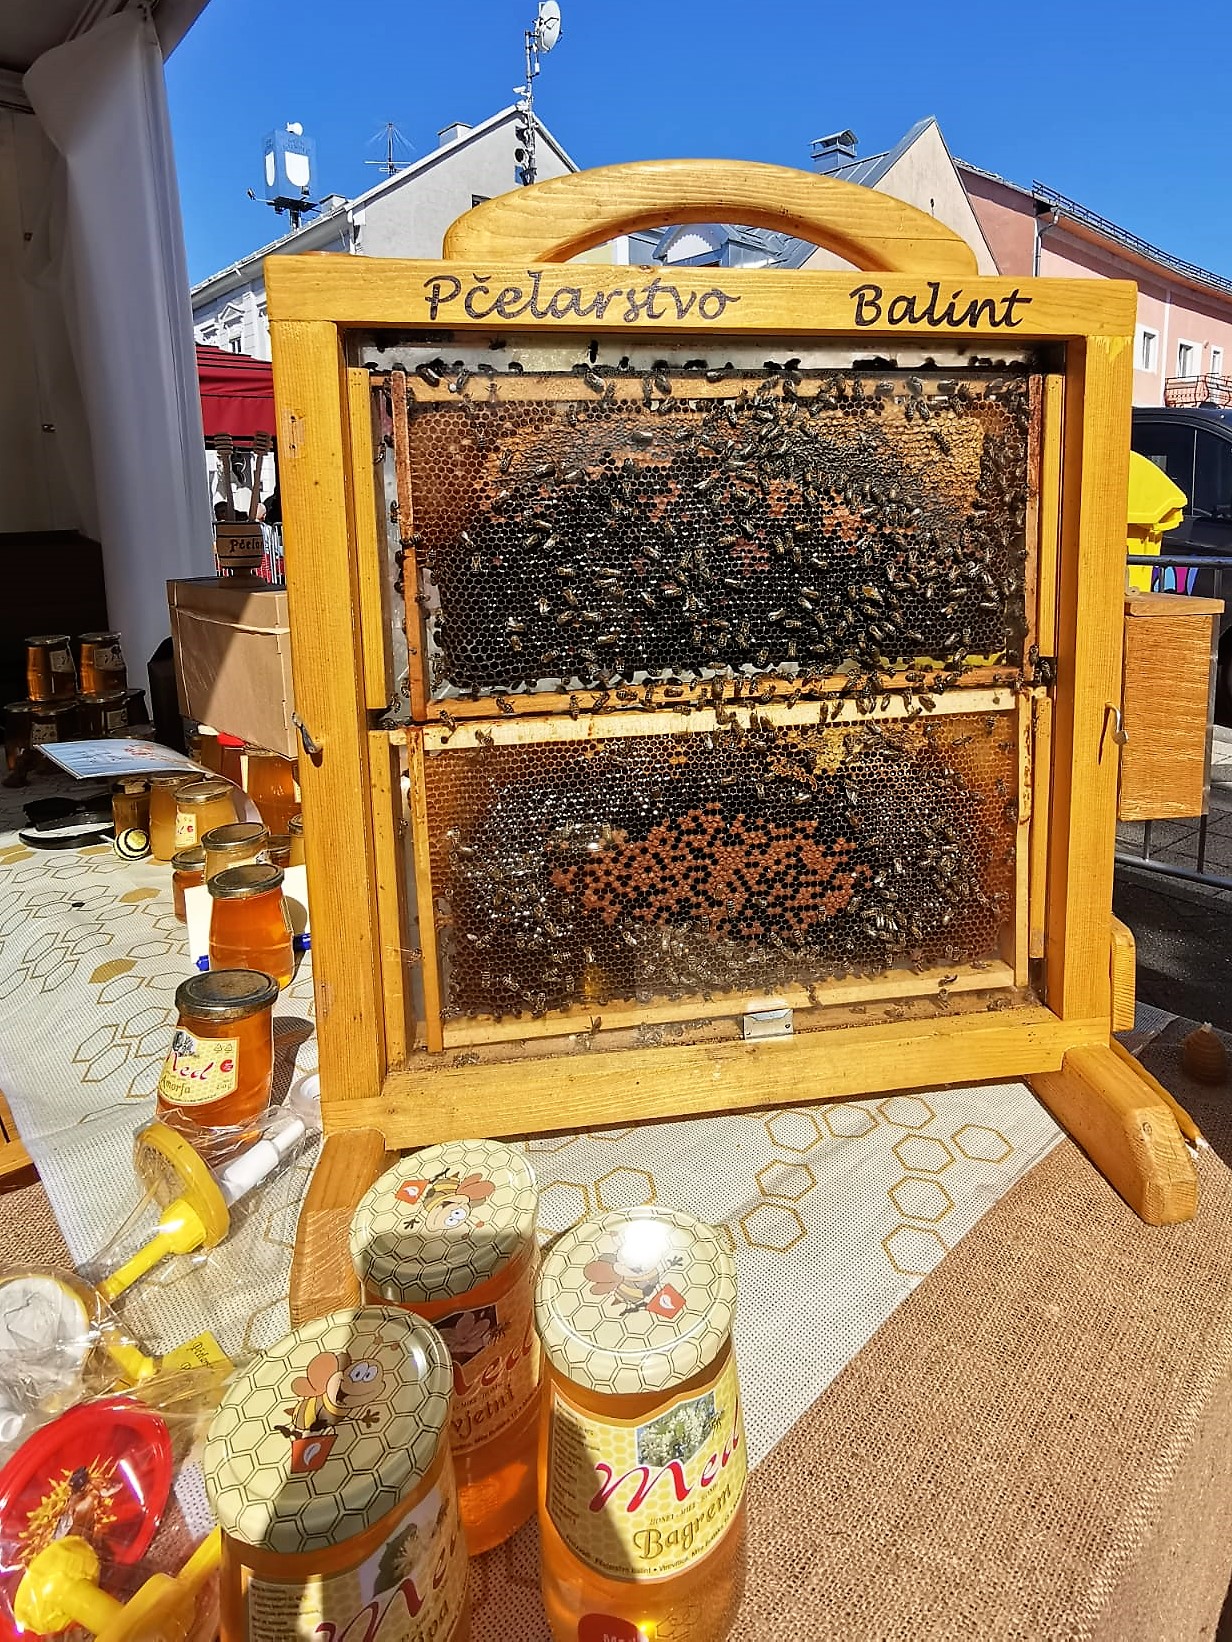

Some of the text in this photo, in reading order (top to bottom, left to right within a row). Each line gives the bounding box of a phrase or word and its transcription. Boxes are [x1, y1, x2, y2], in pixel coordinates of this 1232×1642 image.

[423, 270, 1033, 329] Pčelarstvo Balint
[588, 1393, 741, 1514] Med
[633, 1483, 732, 1560] Bagrem
